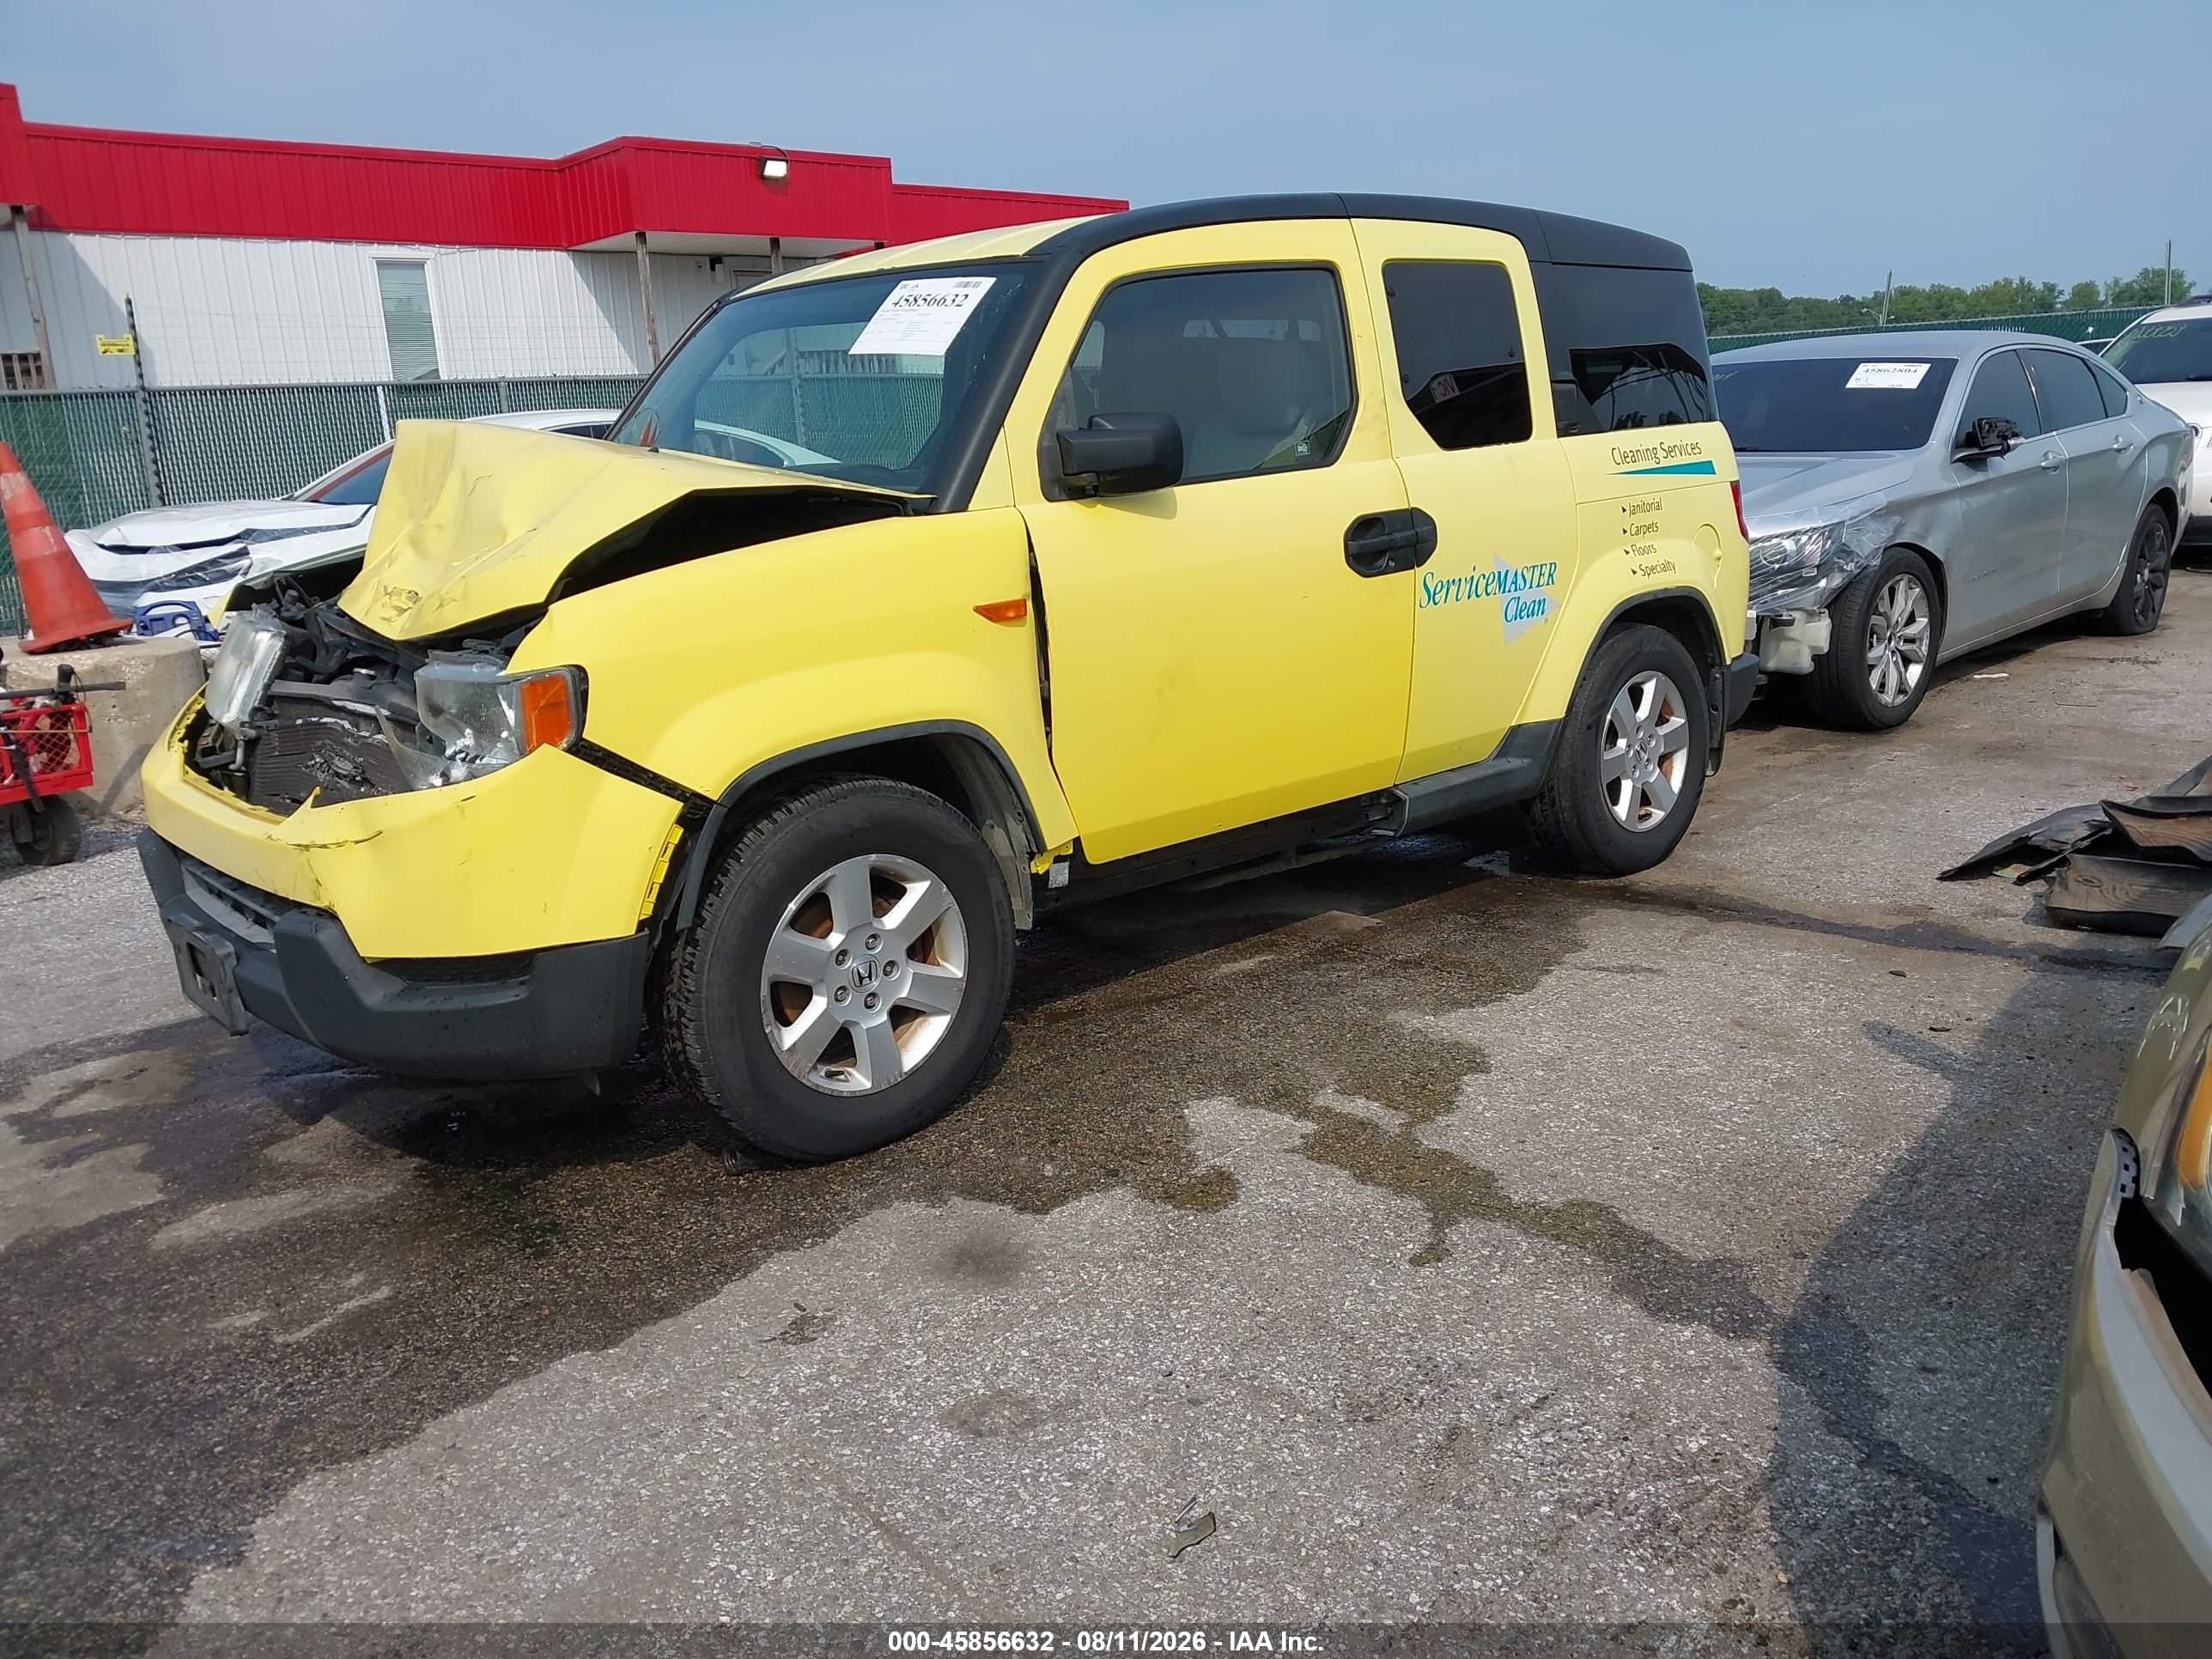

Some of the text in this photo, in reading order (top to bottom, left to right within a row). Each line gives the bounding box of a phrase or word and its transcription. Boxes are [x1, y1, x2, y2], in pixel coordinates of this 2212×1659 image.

[890, 293, 969, 308] 45856632
[1611, 439, 1703, 465] Cleaning Services
[1628, 496, 1663, 518] Janitorial
[1629, 520, 1659, 538] Carpets
[1631, 542, 1657, 557] Floors
[1638, 558, 1676, 581] Specialty
[1419, 562, 1558, 609] ServiceMASTER
[1504, 595, 1547, 623] Clean
